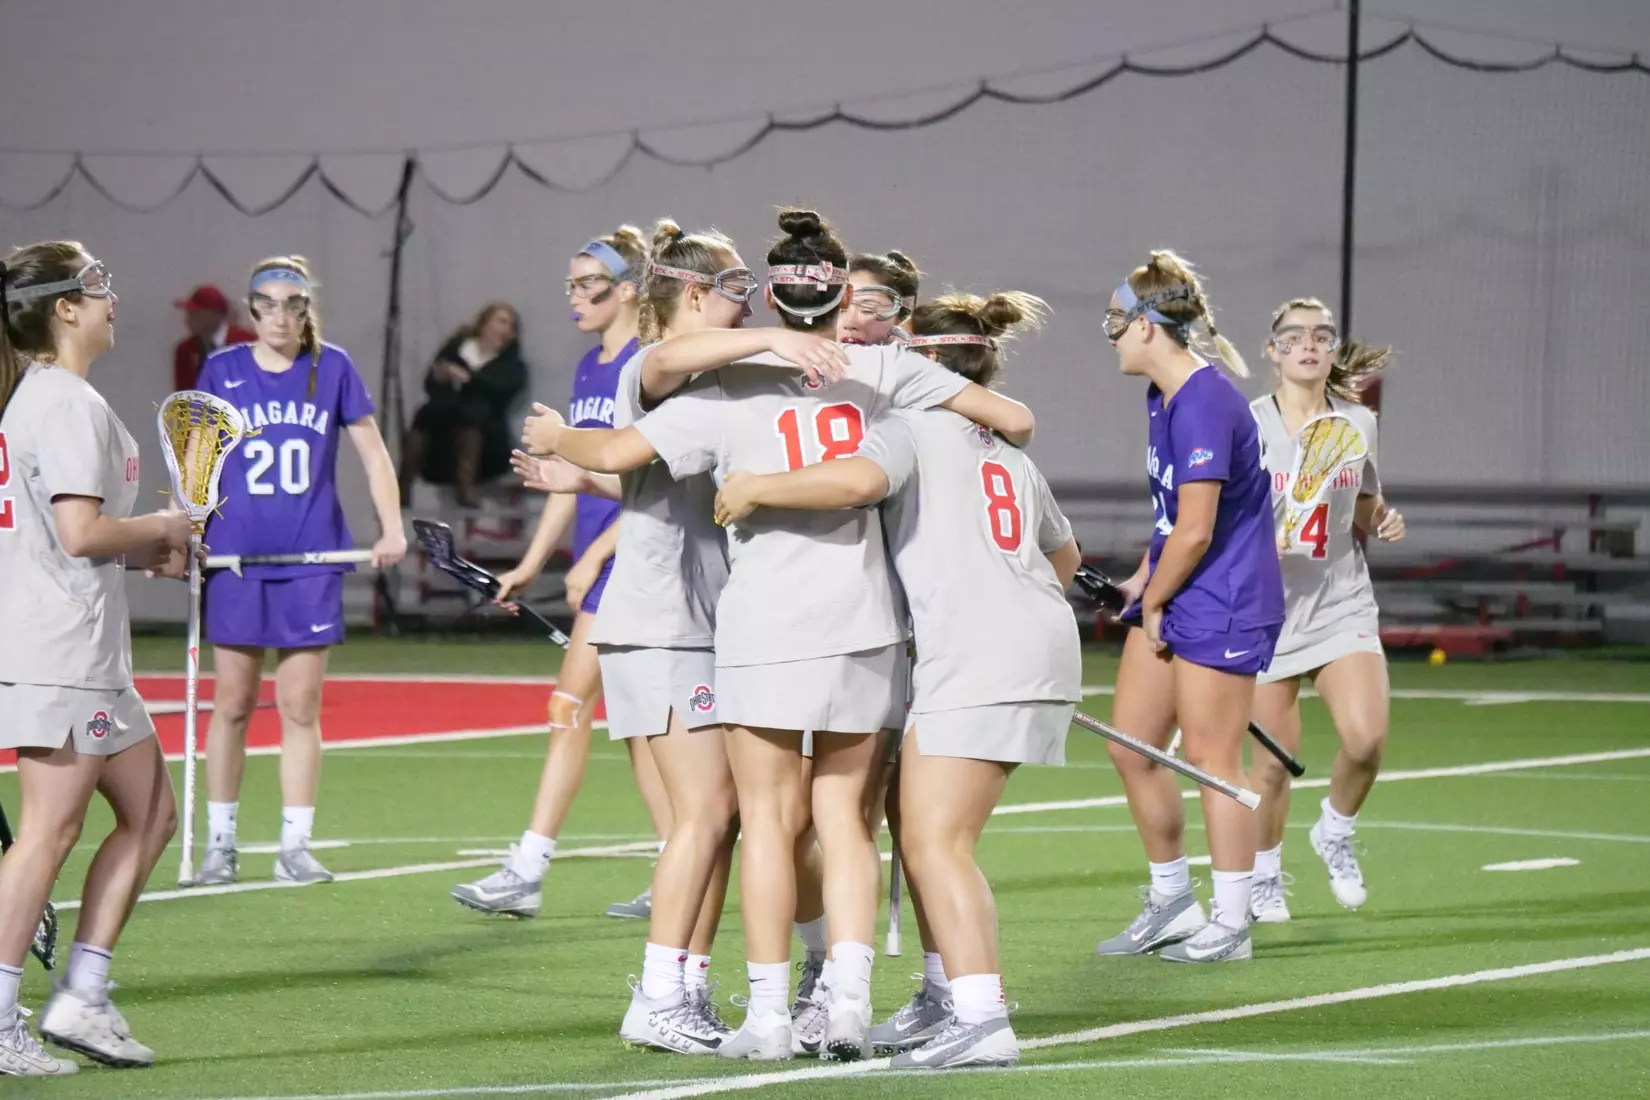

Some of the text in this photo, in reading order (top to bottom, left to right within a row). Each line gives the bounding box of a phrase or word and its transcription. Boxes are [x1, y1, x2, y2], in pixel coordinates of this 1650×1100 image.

[240, 400, 329, 435] IAGARA
[775, 402, 865, 471] 18
[243, 438, 311, 495] 20
[979, 458, 1023, 555] 8
[1299, 502, 1330, 559] 4
